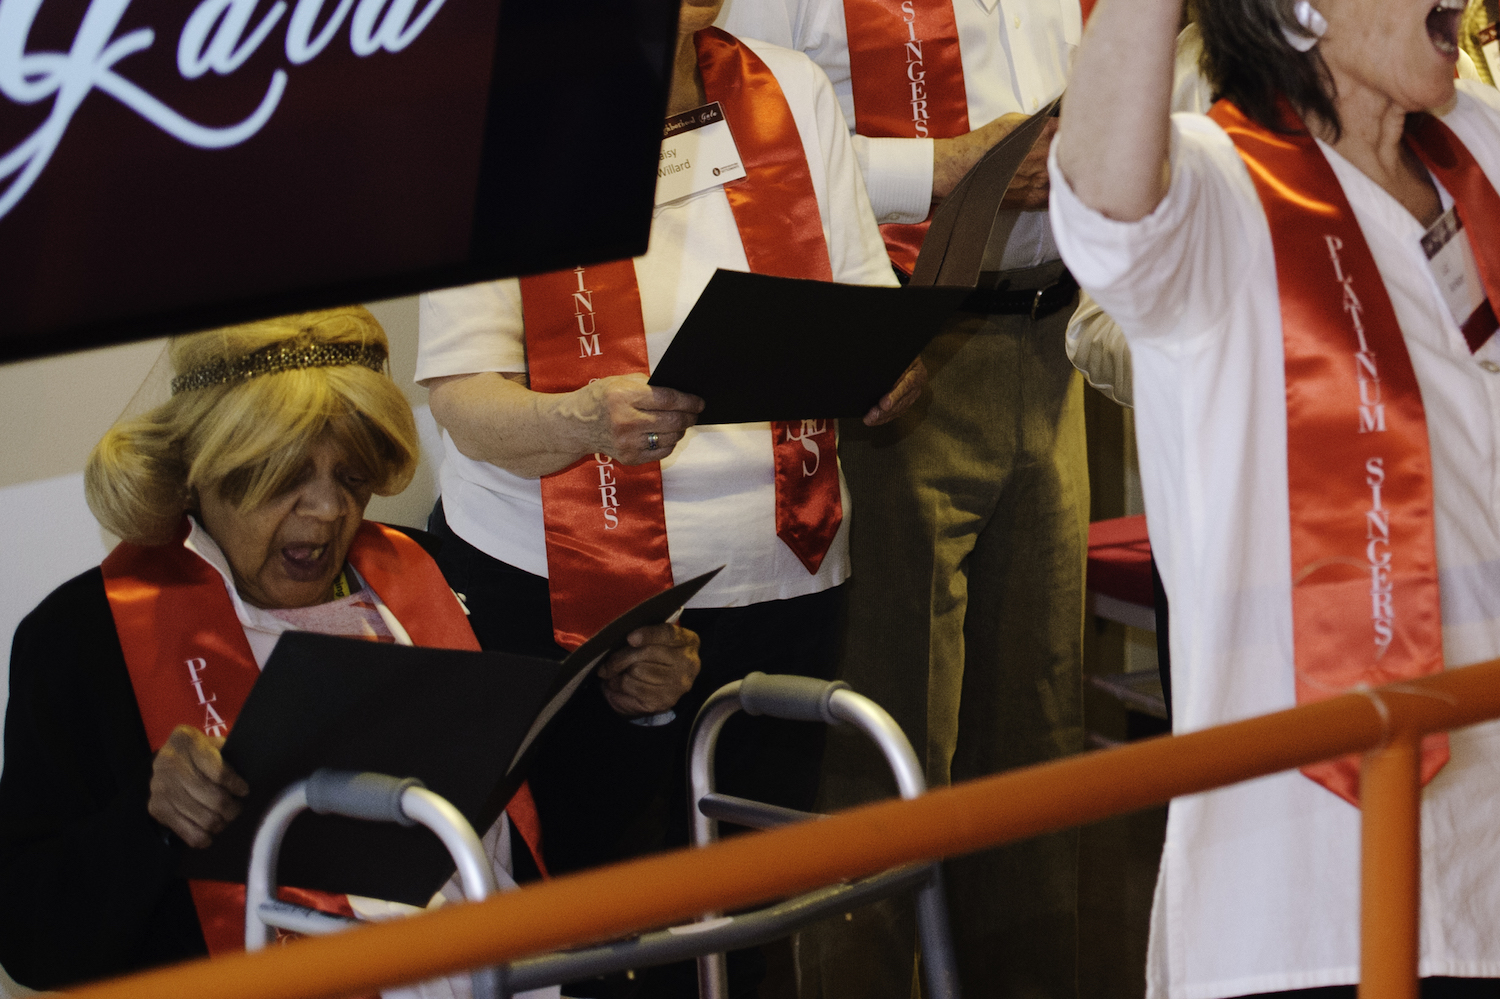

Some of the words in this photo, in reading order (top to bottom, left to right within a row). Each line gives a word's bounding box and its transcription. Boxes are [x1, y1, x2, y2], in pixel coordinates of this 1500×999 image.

[901, 0, 930, 138] SINGERS
[657, 158, 691, 178] Willard
[660, 148, 677, 161] aisy
[572, 268, 603, 359] INUM
[1366, 457, 1394, 650] SINGERS
[185, 657, 228, 738] PLAT
